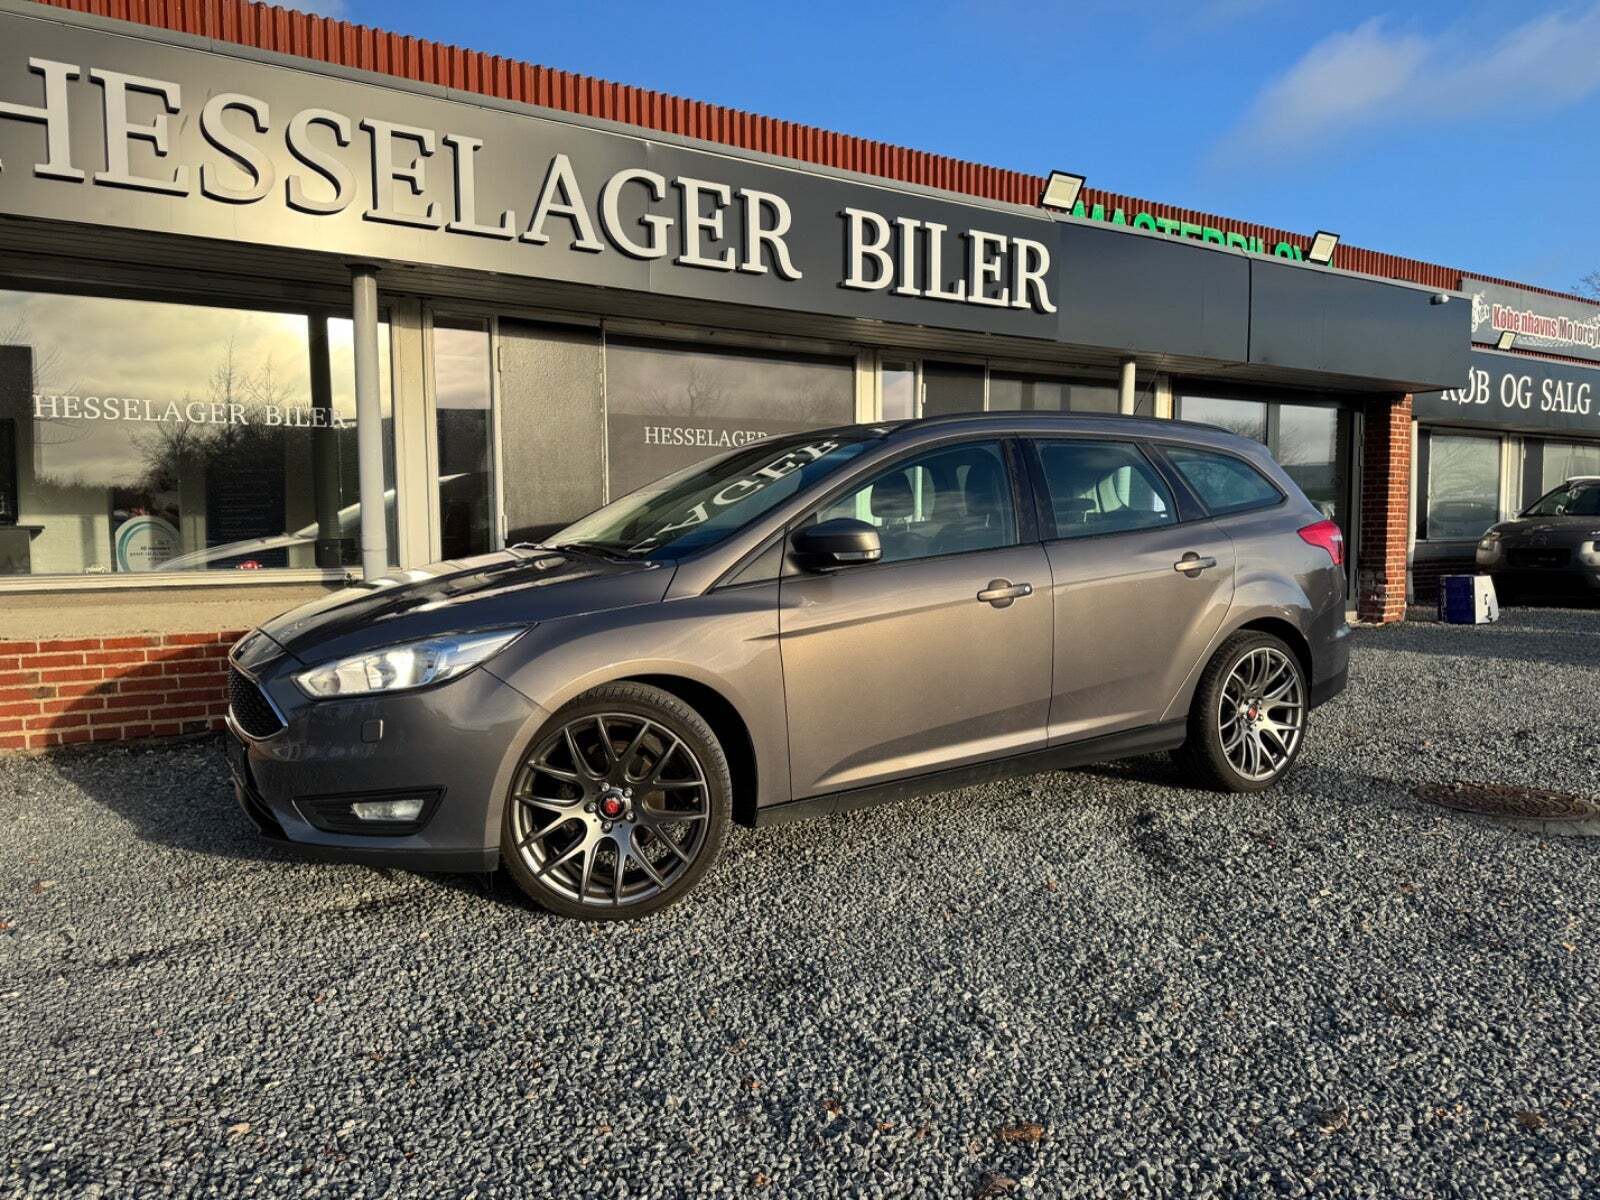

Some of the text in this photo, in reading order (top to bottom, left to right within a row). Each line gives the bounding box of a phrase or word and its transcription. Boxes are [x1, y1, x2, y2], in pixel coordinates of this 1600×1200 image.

[0, 57, 802, 281] HESSELAGER
[842, 207, 1057, 314] BILER
[33, 394, 346, 429] HESSELAGER BILER
[1500, 373, 1533, 409] OG
[1541, 378, 1592, 415] SALG
